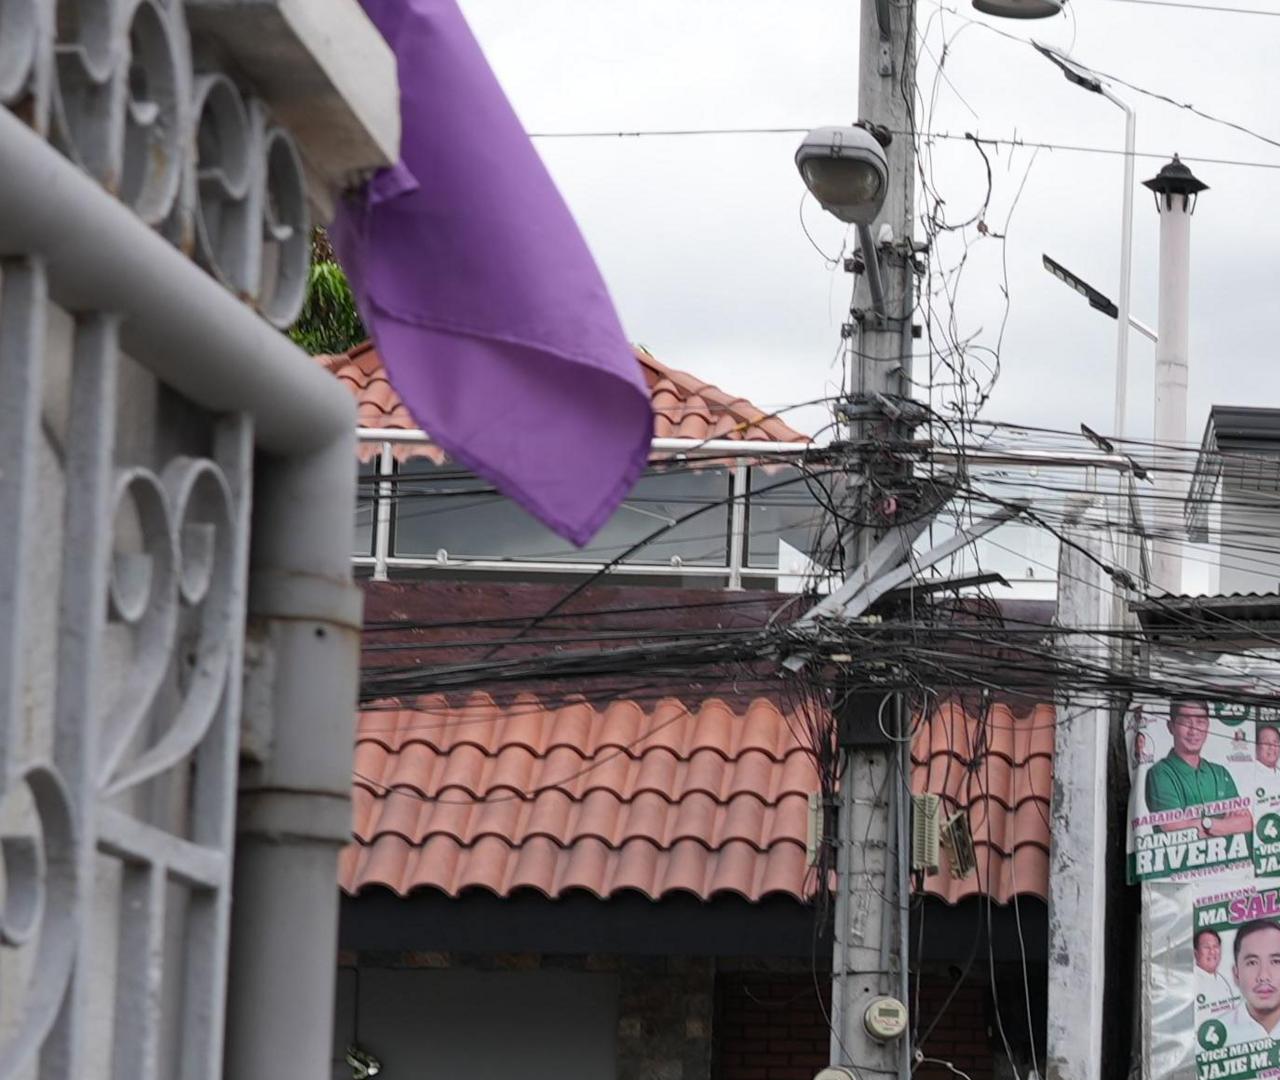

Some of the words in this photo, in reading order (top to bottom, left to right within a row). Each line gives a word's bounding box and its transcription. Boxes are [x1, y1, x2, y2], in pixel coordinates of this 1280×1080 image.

[1263, 819, 1279, 839] 4
[1136, 833, 1249, 875] RIVERA
[1205, 1026, 1220, 1046] 4
[1249, 1051, 1273, 1071] M.
